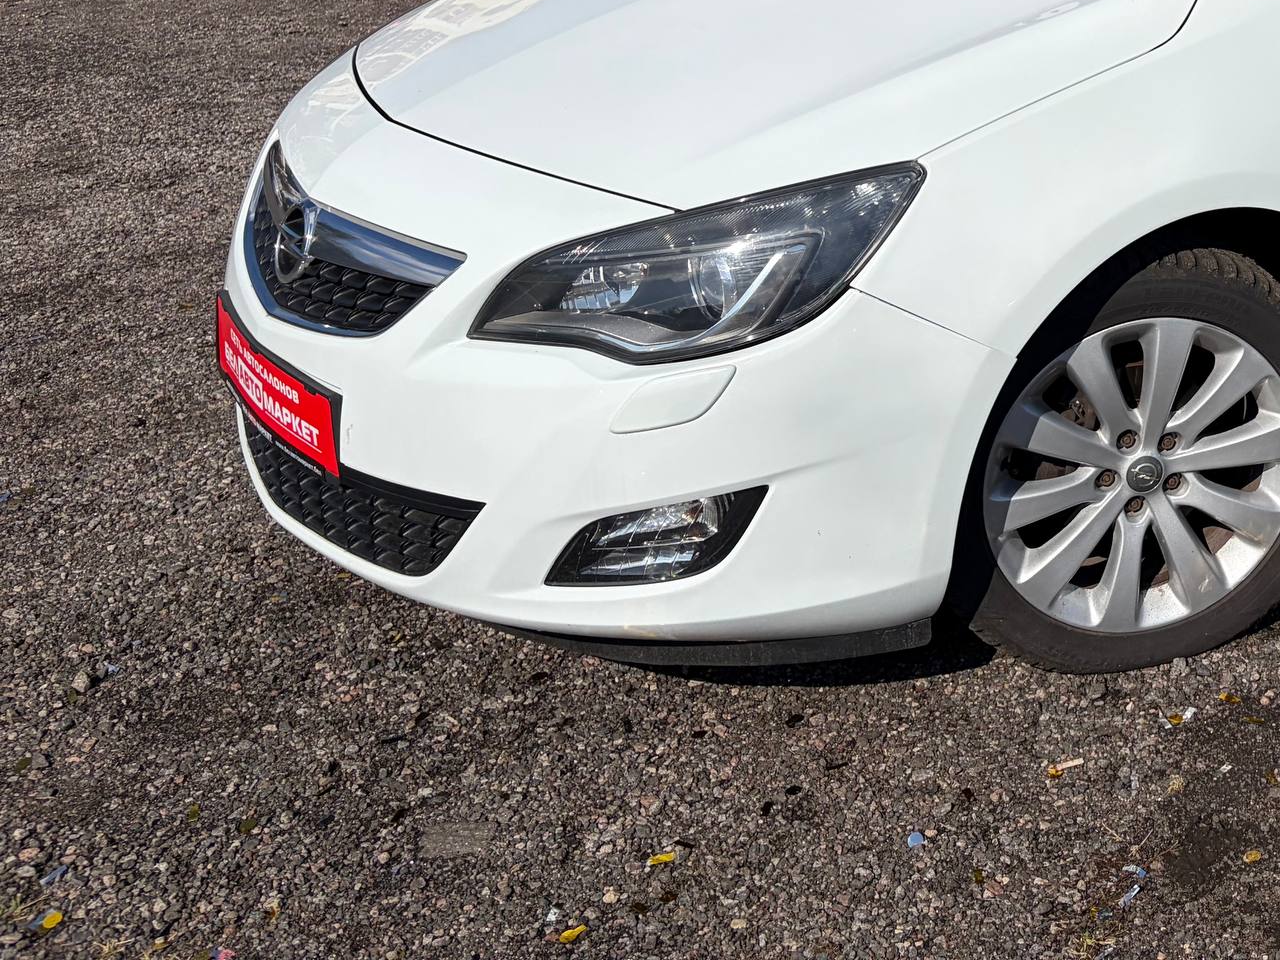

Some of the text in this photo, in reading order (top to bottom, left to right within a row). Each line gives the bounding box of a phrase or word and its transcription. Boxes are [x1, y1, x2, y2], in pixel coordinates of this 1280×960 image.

[224, 340, 239, 373] БЕЛ
[239, 360, 262, 408] АВТО
[263, 390, 320, 447] МАРКЕТ
[243, 348, 300, 405] АВТОСАЛОНОВ
